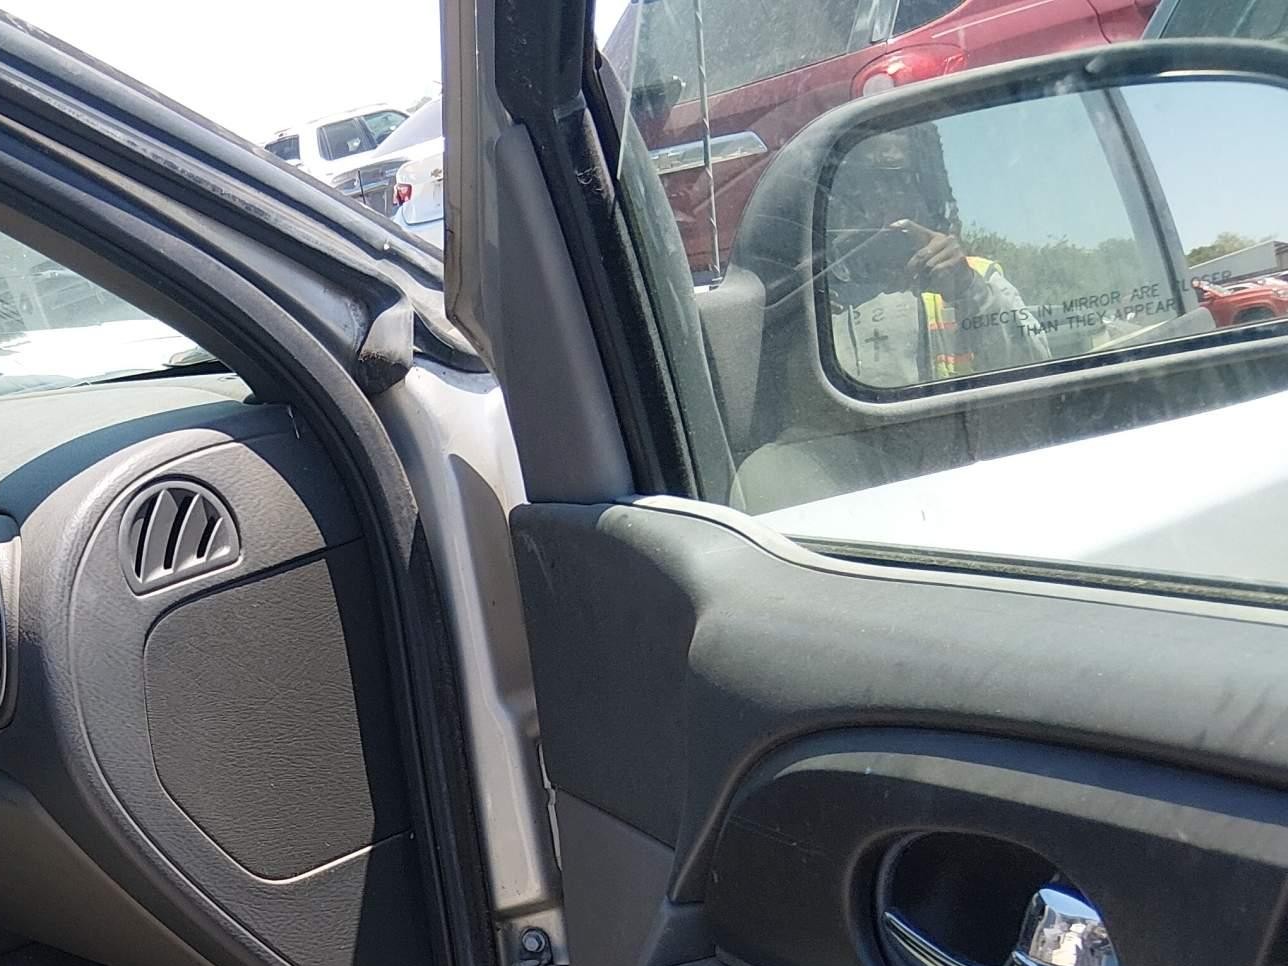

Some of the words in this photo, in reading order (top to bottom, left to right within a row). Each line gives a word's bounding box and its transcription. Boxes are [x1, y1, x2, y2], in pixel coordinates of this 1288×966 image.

[962, 308, 1029, 331] OBJECTS
[1038, 304, 1053, 318] IN
[1063, 291, 1121, 313] MIRROR
[1130, 283, 1160, 301] ARE
[1176, 269, 1232, 292] LOSER
[1017, 319, 1058, 337] THAN
[1066, 310, 1107, 329] THEY
[1114, 299, 1177, 320] APPEAR
